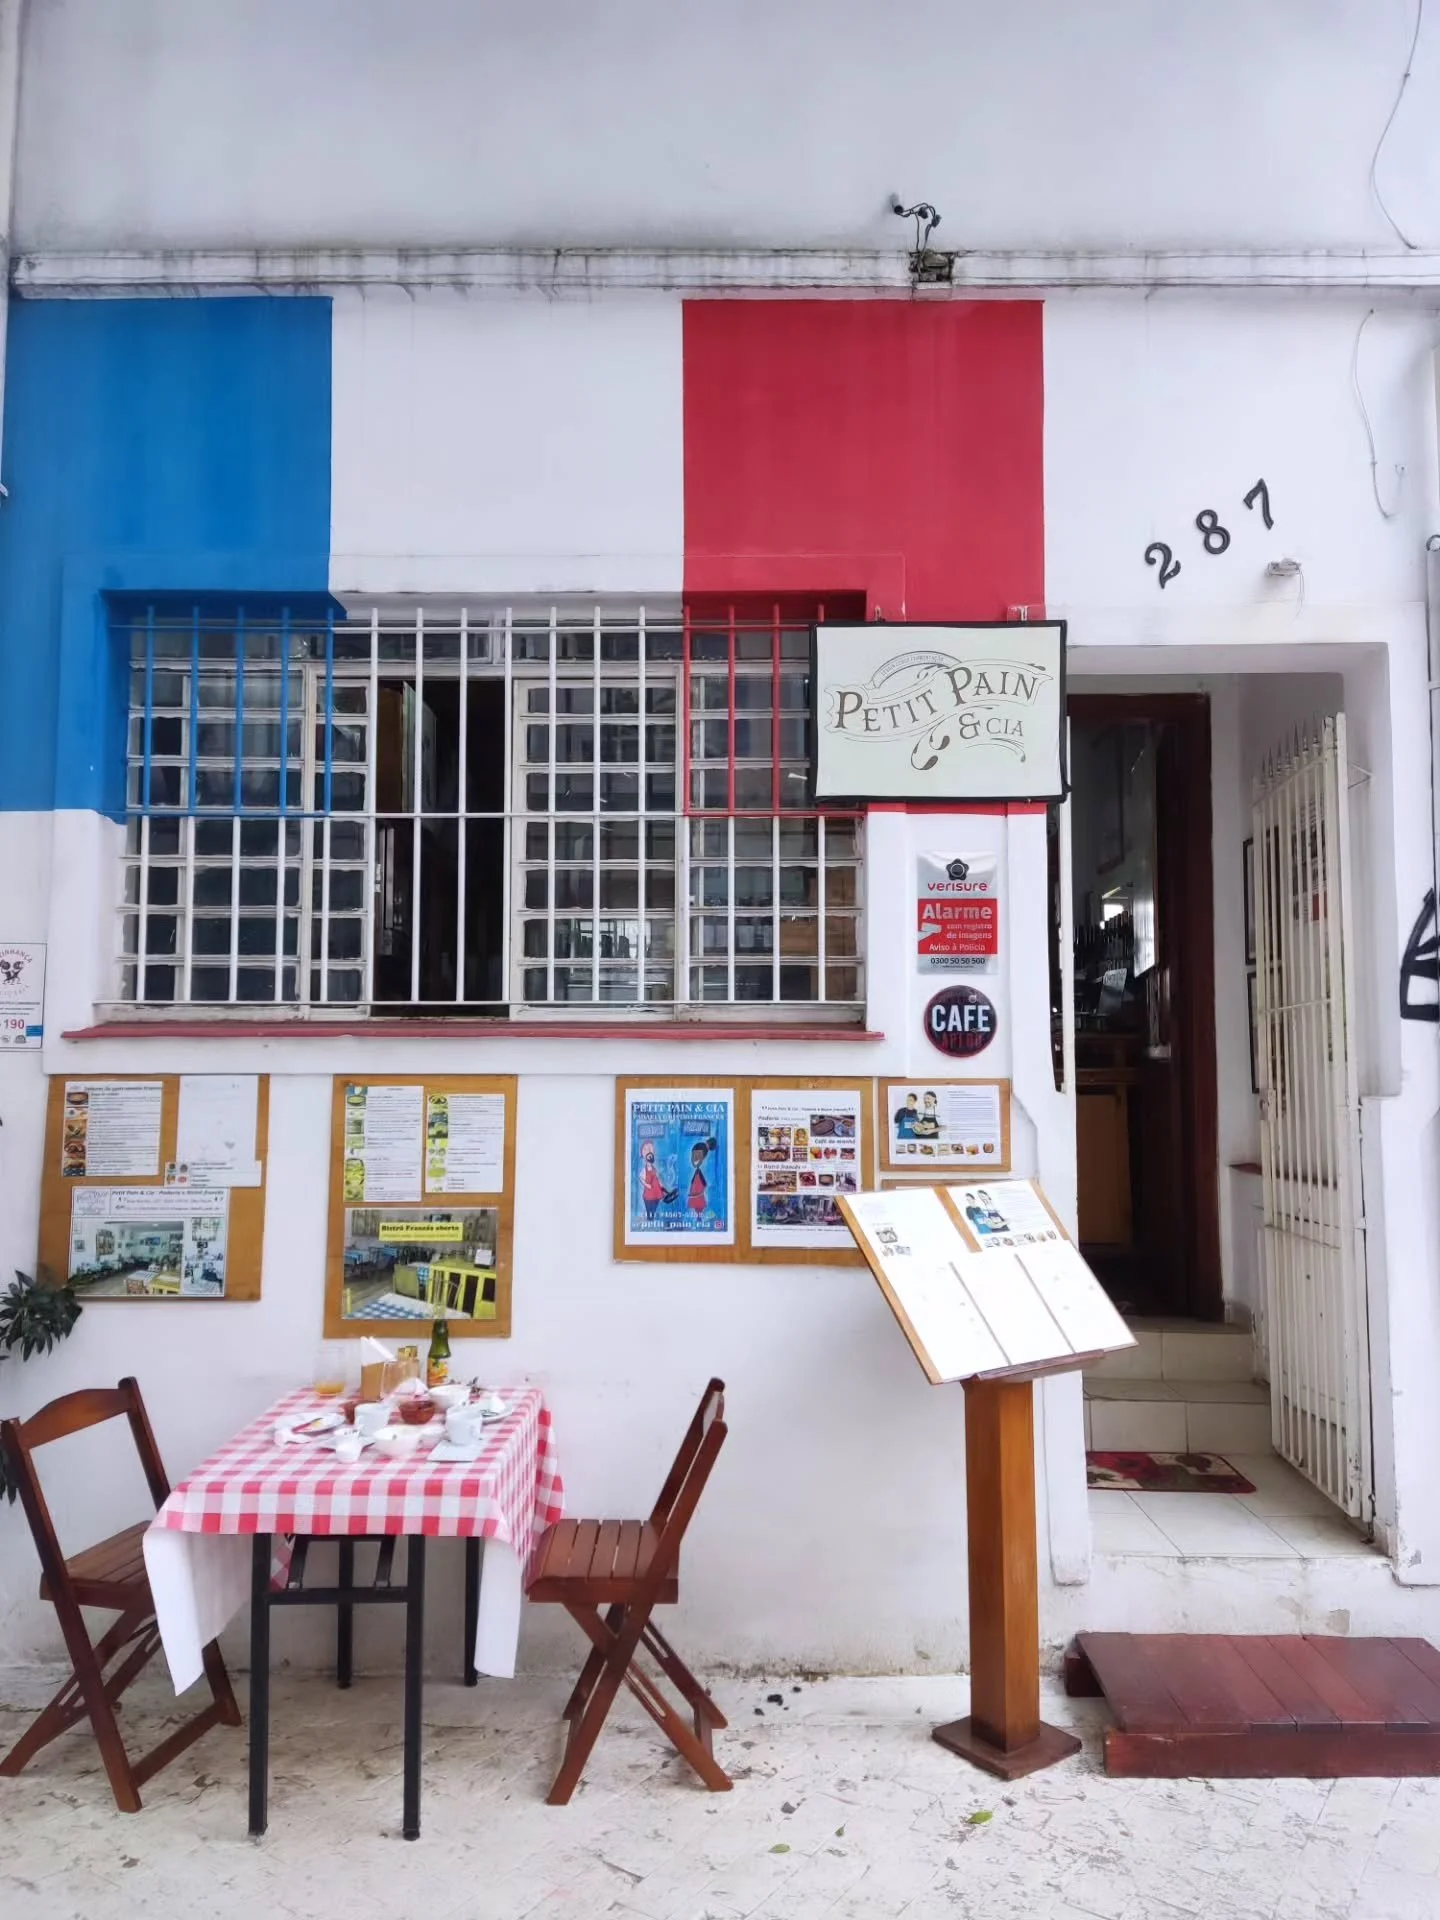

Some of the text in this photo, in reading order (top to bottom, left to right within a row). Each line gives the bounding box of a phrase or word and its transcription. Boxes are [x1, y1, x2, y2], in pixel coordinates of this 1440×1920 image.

[1144, 478, 1275, 589] 287
[835, 689, 938, 732] PETIT
[945, 666, 1039, 707] PAIN
[958, 711, 1024, 740] & CIA
[927, 881, 988, 892] verisure
[922, 902, 993, 920] Alarme
[963, 923, 993, 931] registro
[946, 931, 993, 941] de imagens
[929, 943, 950, 951] Aviso
[694, 1103, 704, 1113] &
[705, 1103, 725, 1113] CIA
